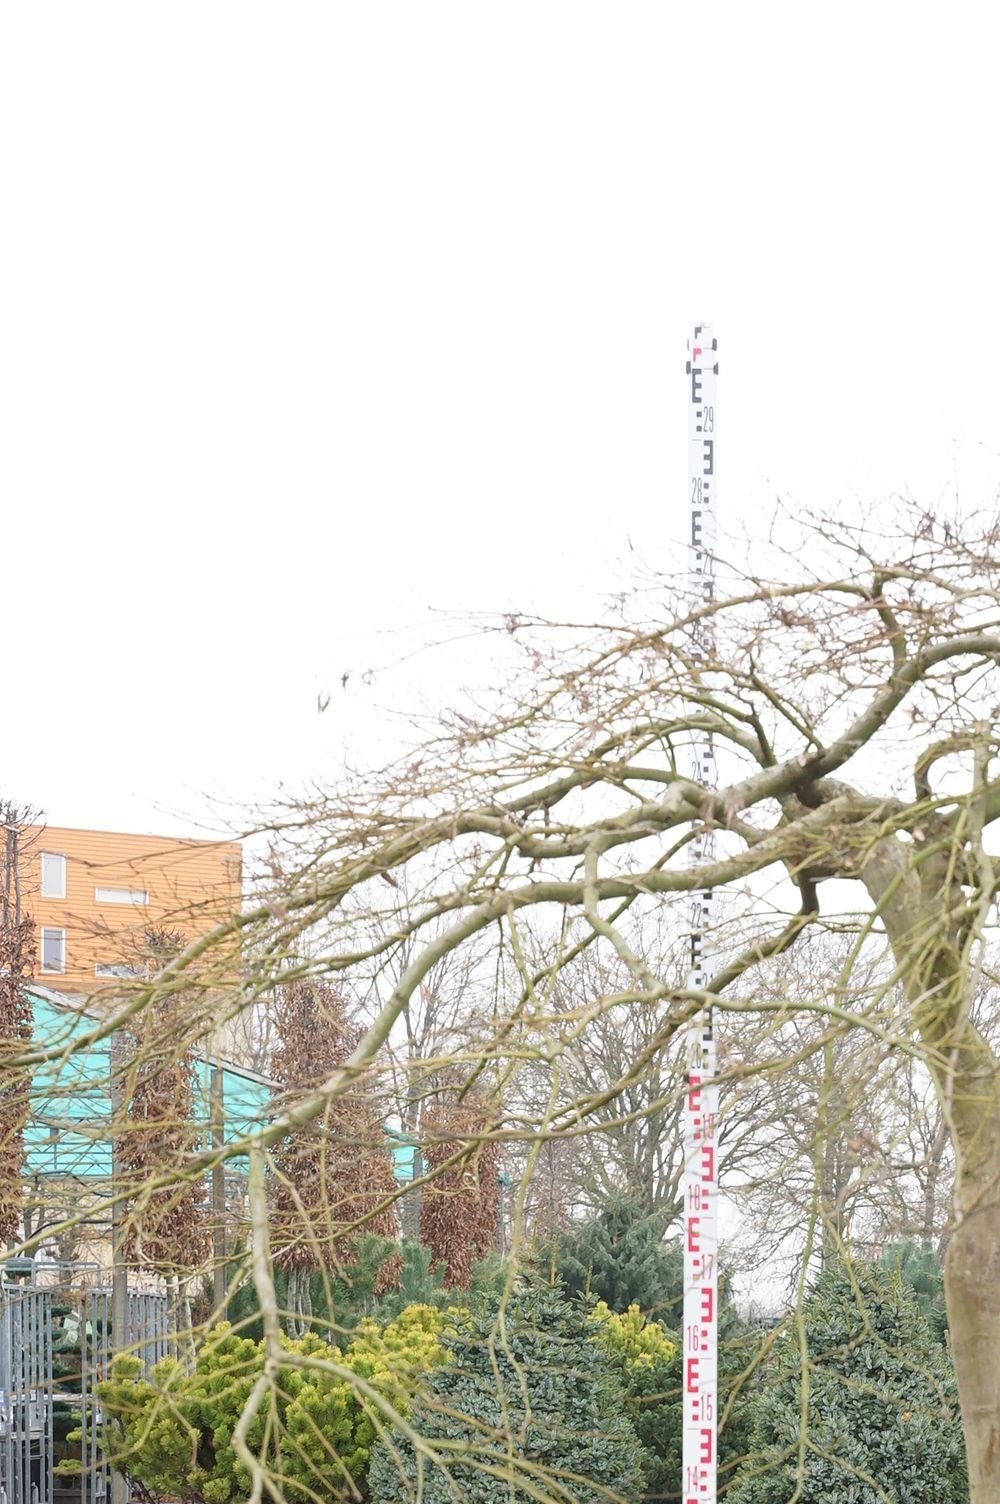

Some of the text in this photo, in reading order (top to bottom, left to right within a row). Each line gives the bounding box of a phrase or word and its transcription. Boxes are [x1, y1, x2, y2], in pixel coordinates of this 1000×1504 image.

[703, 406, 714, 433] 29
[692, 477, 702, 504] 28
[688, 1184, 700, 1211] 18
[702, 1254, 714, 1280] 17
[687, 1325, 699, 1351] 16
[701, 1394, 713, 1421] 15
[687, 1466, 698, 1492] 14
